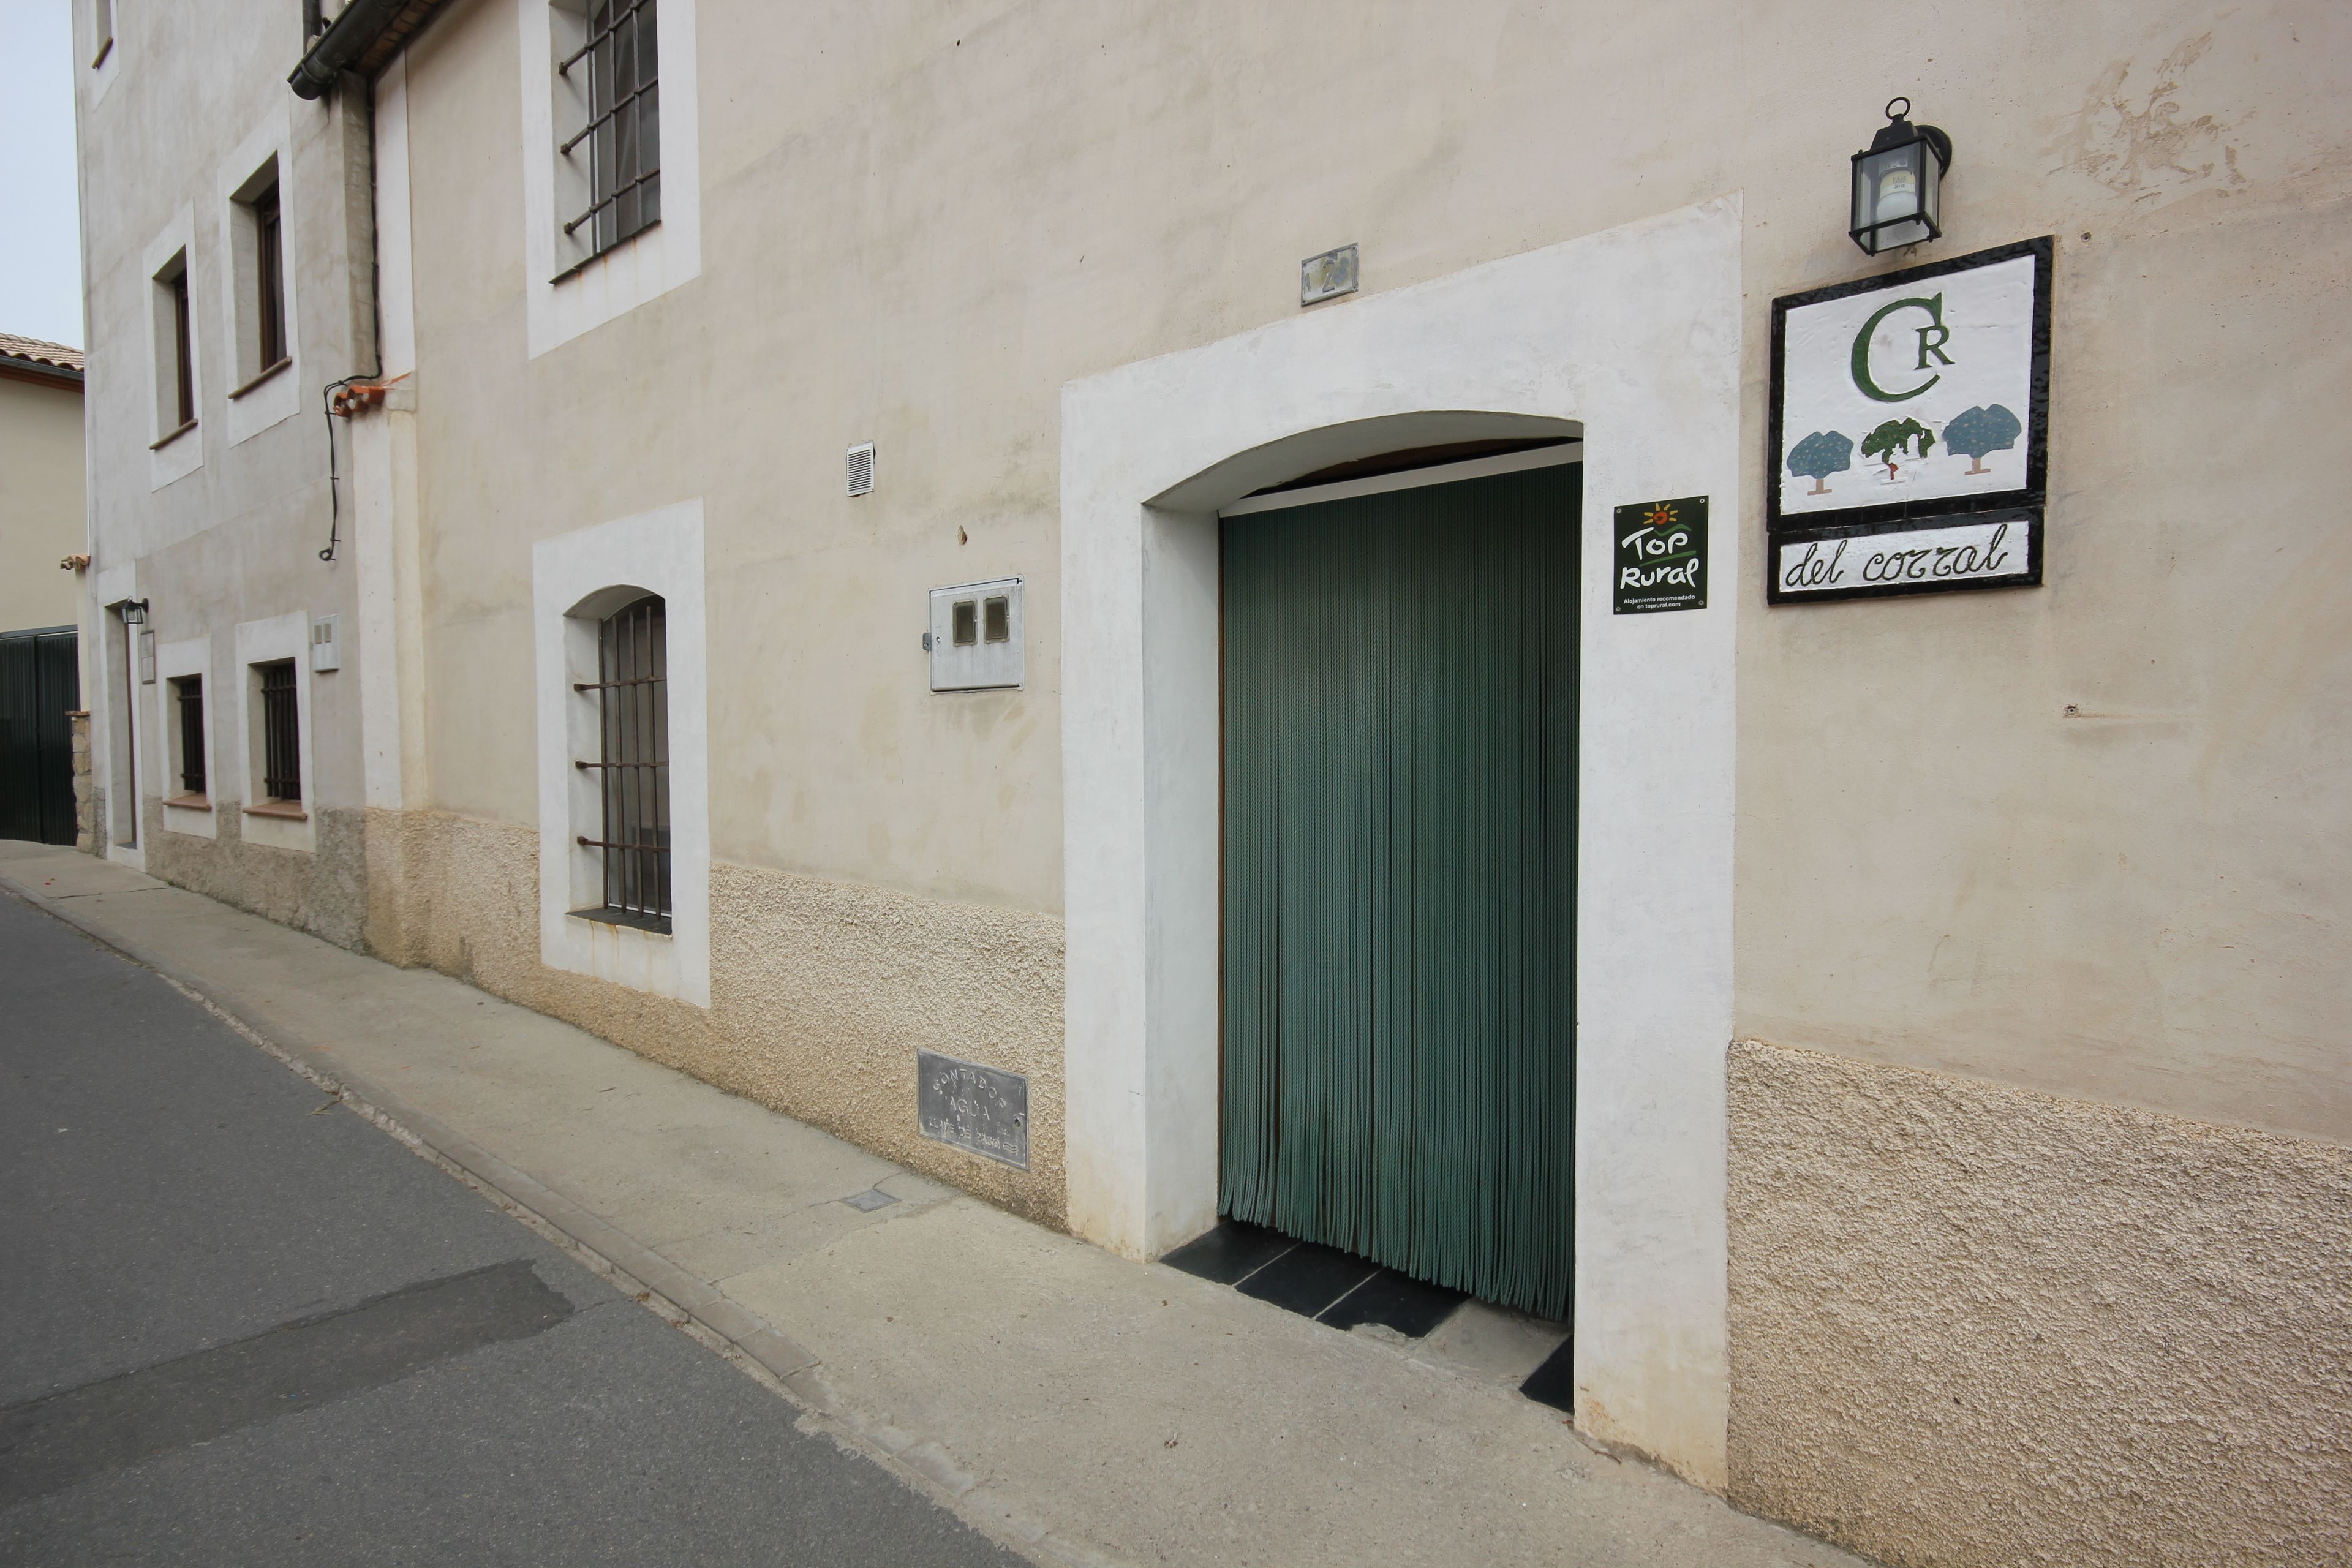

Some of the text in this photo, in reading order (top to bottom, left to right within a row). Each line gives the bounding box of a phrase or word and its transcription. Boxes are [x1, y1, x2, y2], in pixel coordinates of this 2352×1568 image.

[1322, 259, 1335, 293] 2
[1621, 527, 1689, 560] Top
[1785, 524, 2009, 587] del corral
[1620, 557, 1700, 589] Rural
[933, 1068, 1006, 1110] CONTADOR
[950, 1095, 990, 1121] AGUA
